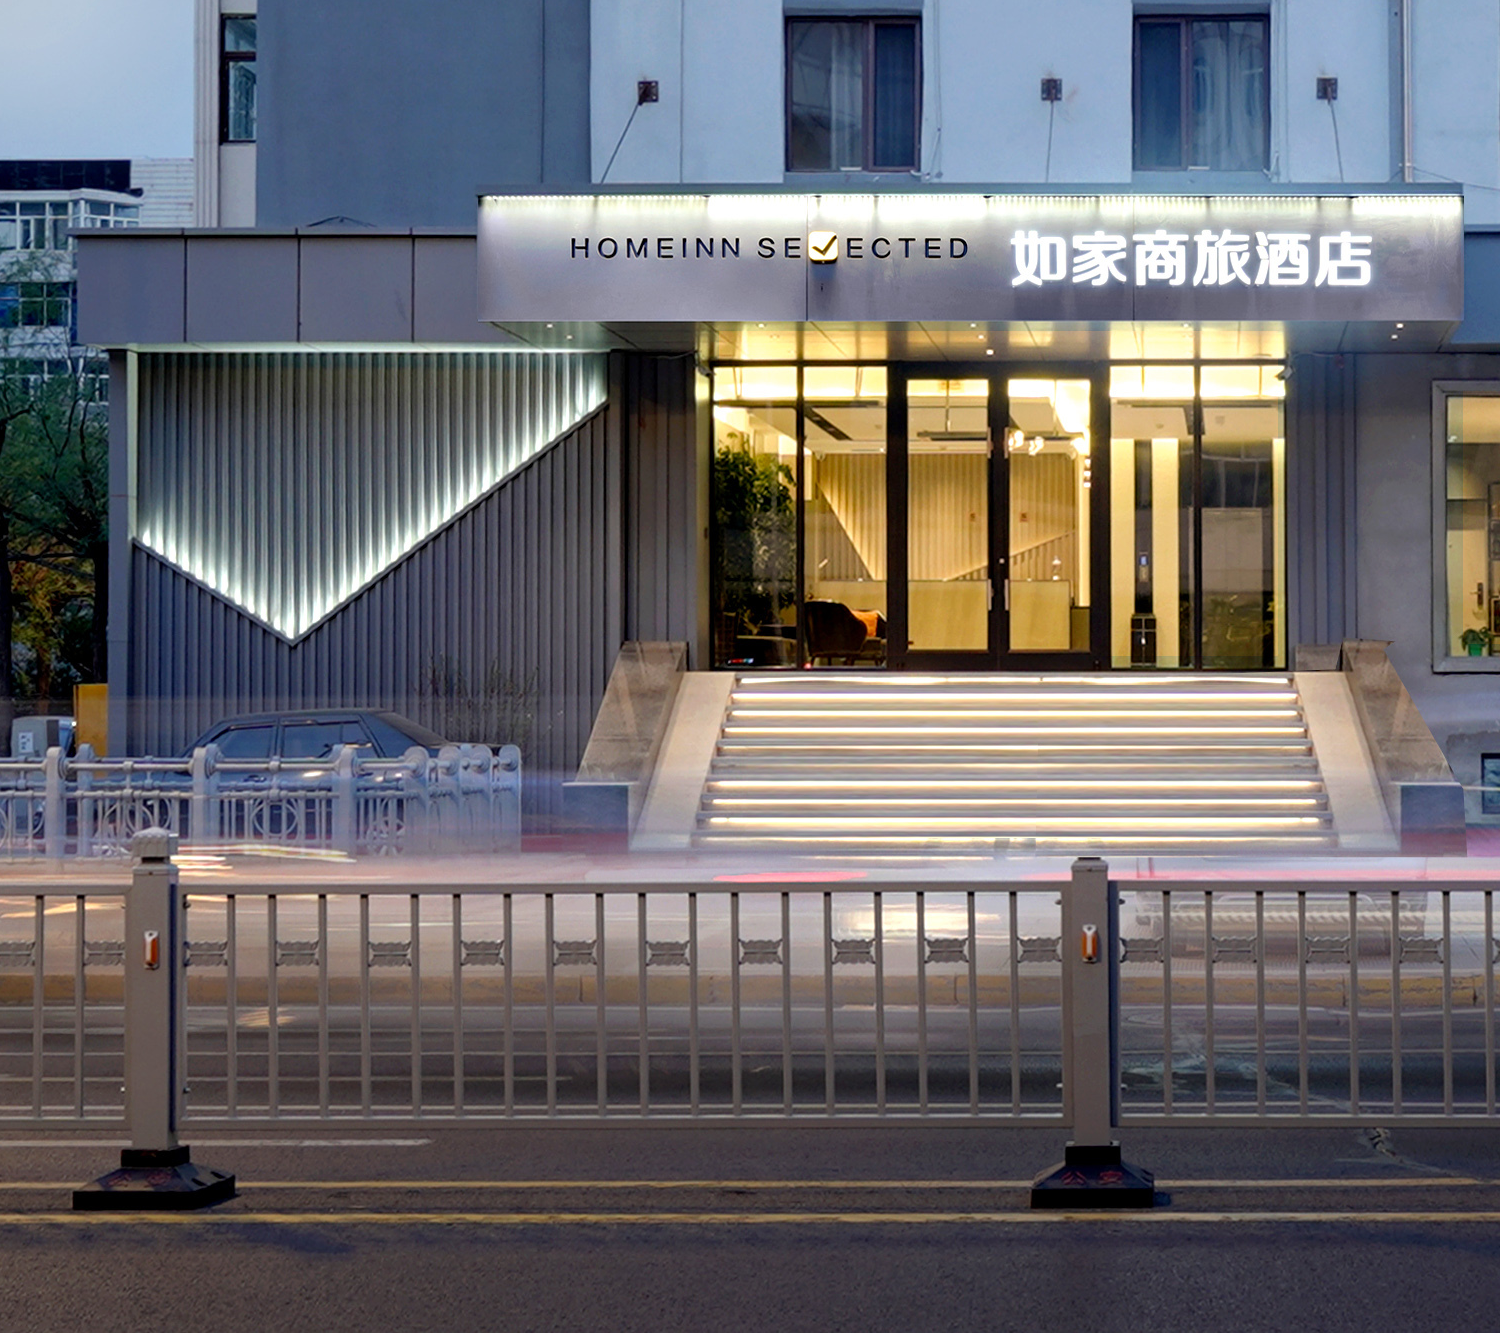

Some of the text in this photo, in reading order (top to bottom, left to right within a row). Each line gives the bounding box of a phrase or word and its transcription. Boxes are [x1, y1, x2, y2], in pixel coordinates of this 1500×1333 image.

[571, 237, 740, 259] HOMEINN
[1010, 229, 1373, 287] 如家商旅酒店
